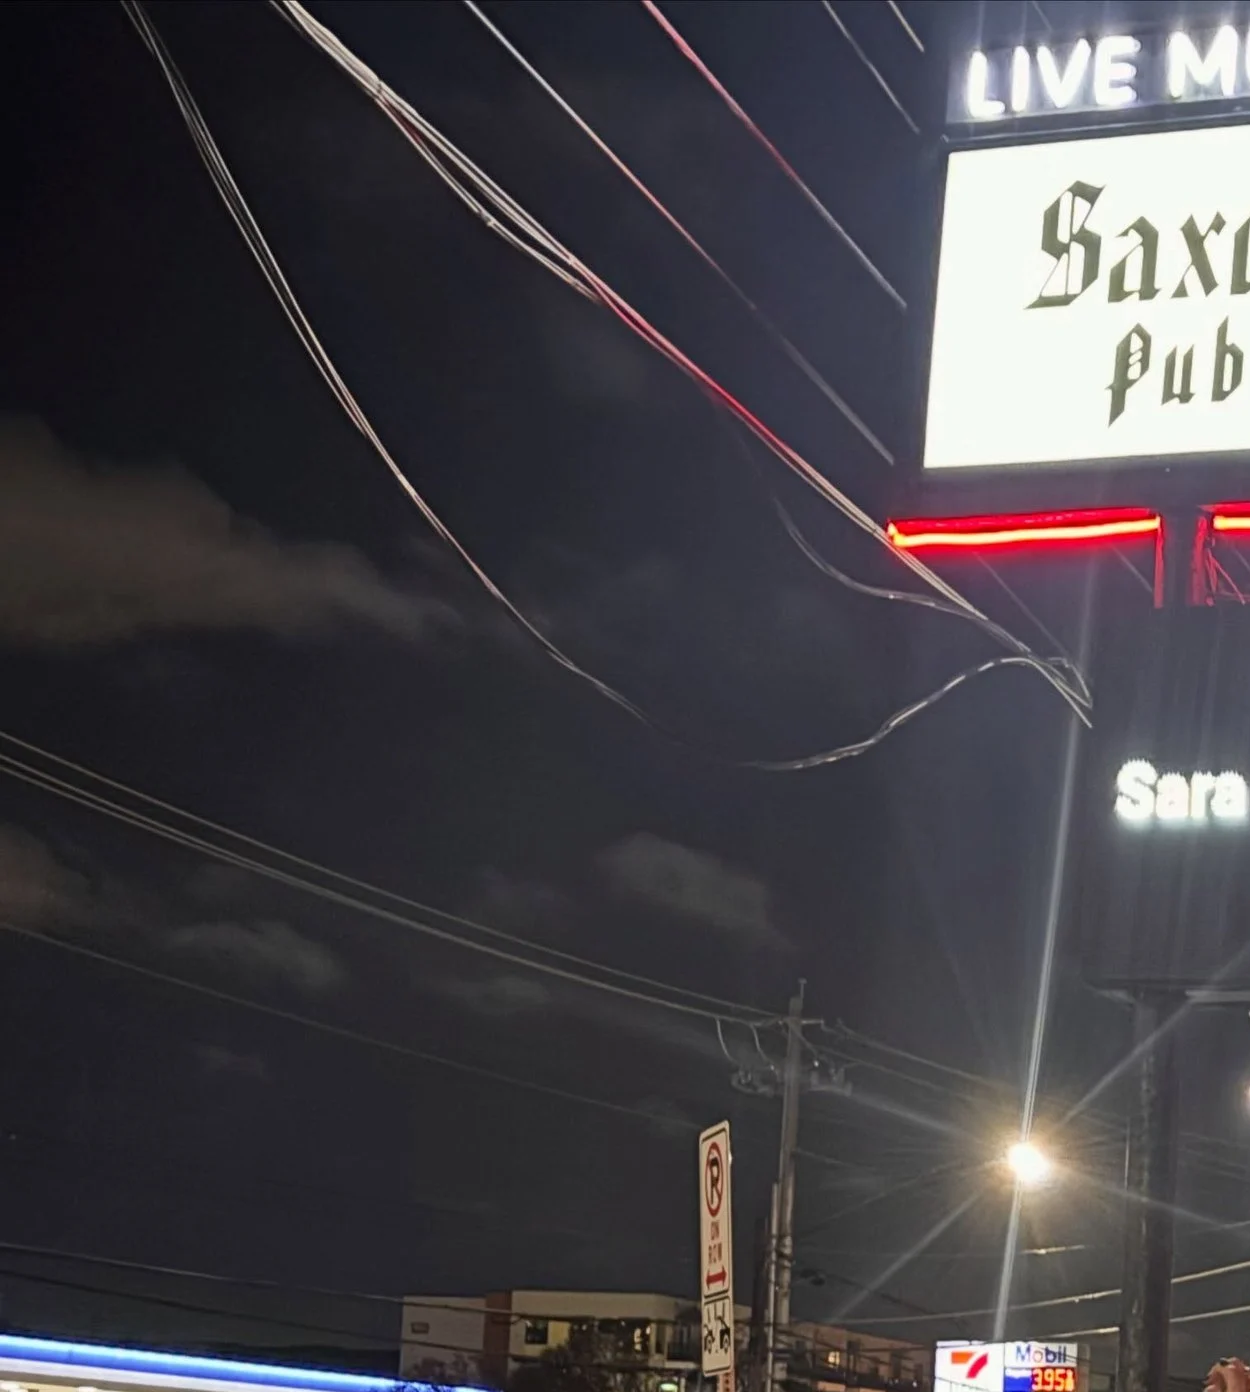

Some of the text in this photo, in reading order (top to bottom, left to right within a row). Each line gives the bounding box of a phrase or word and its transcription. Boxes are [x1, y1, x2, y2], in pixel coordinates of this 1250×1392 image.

[966, 35, 1142, 118] LIVE
[1105, 315, 1245, 429] Pub
[1114, 757, 1250, 822] Sara
[1016, 1344, 1067, 1364] Mobil
